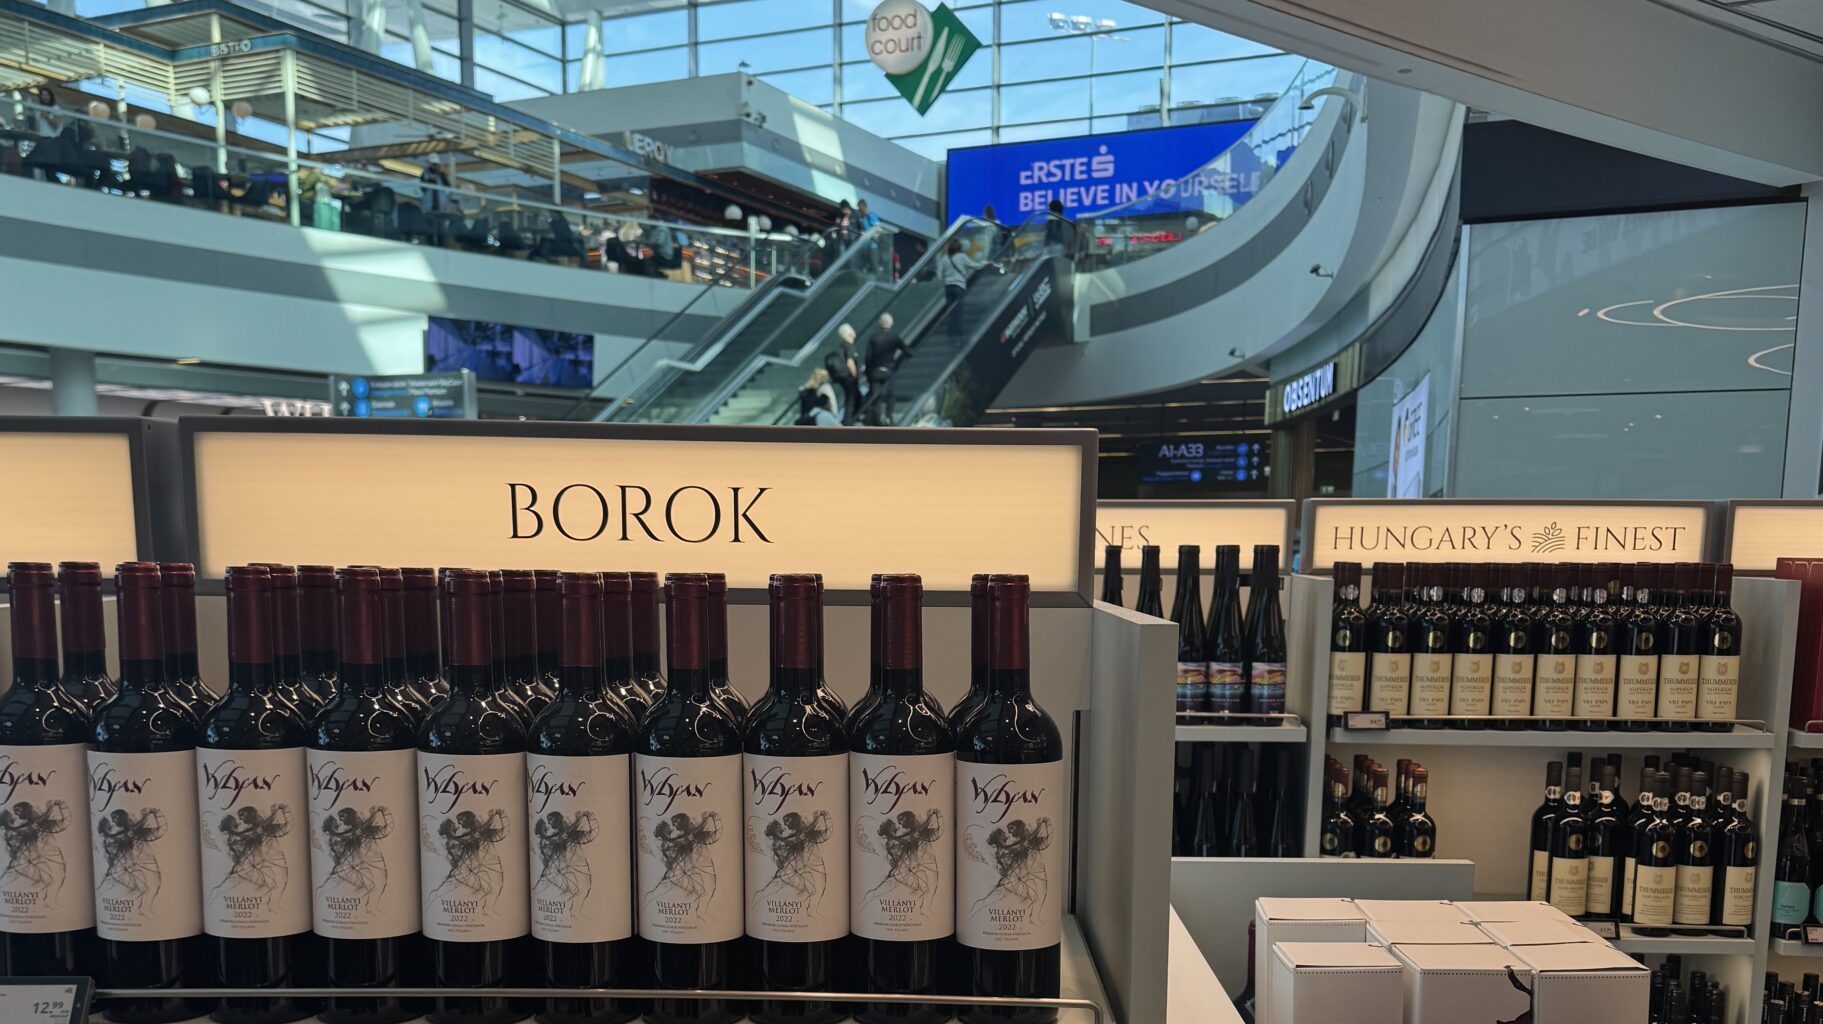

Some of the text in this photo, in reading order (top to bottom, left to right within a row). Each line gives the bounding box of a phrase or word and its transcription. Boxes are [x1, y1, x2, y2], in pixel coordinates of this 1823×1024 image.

[872, 8, 918, 32] food
[870, 32, 923, 56] court
[1019, 157, 1089, 186] ERSTE
[1019, 184, 1110, 213] BELIEVE
[1114, 181, 1138, 204] IN
[506, 481, 776, 545] BOROK
[1574, 525, 1687, 552] FINEST
[103, 905, 133, 913] MERLOT
[226, 902, 260, 910] MERLOT
[327, 903, 360, 911] MERLOT
[442, 906, 476, 914] MERLOT
[538, 906, 564, 914] MERLOT
[768, 906, 801, 915] MERLOT
[881, 906, 915, 914] MERLOT
[657, 907, 690, 916] MERLOT
[990, 914, 1025, 923] MERLOT
